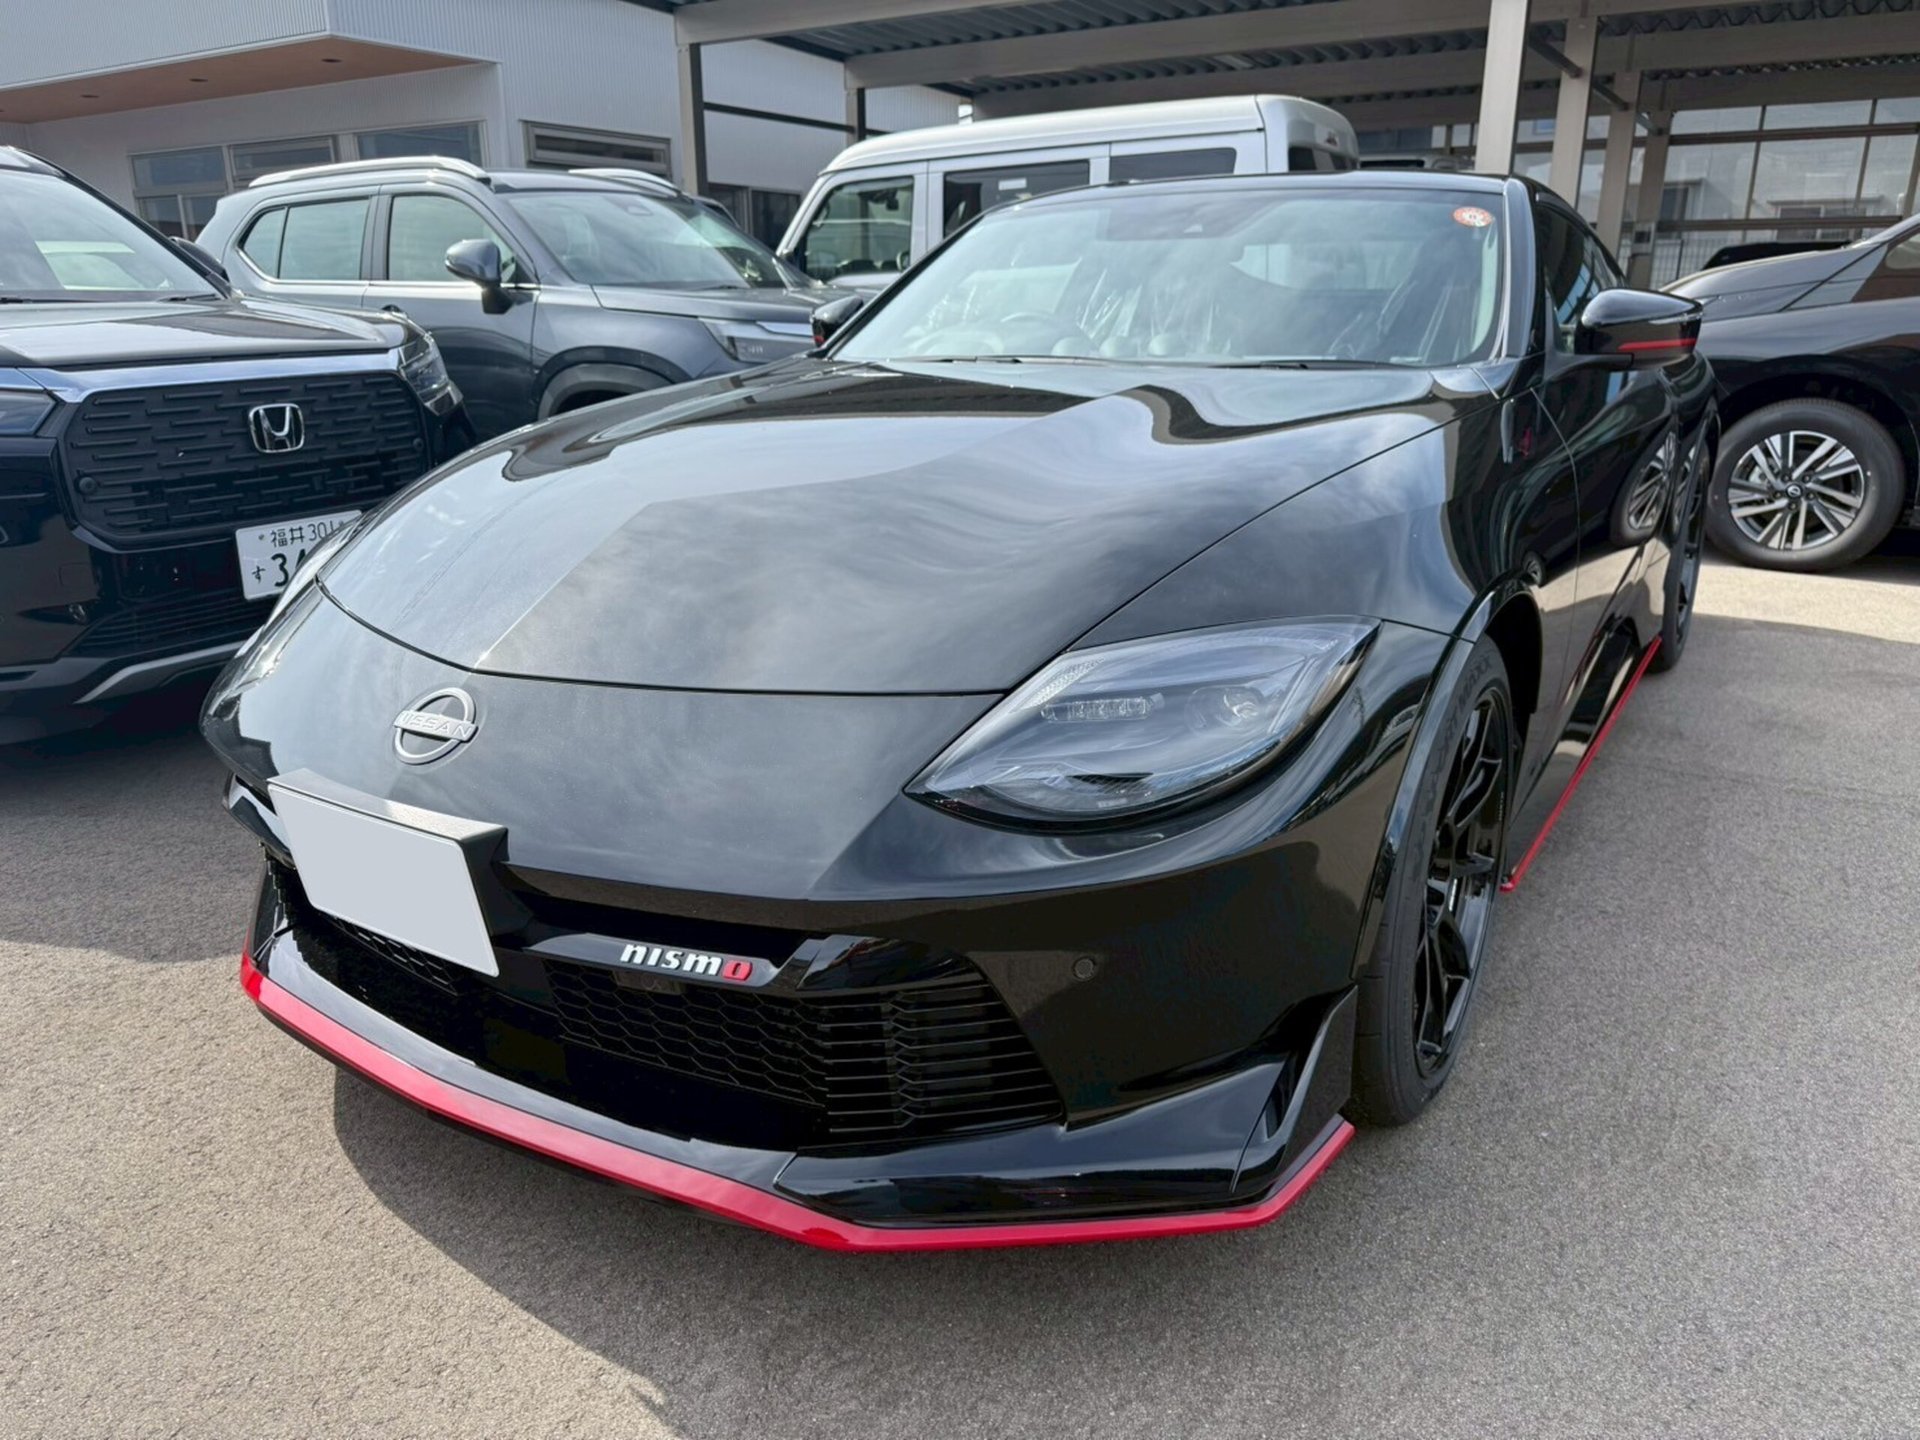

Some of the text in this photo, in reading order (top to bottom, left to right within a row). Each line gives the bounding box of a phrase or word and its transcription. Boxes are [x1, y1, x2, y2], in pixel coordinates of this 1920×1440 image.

[270, 526, 305, 548] 福井
[251, 548, 306, 587] す 3
[400, 711, 473, 739] NISSAN
